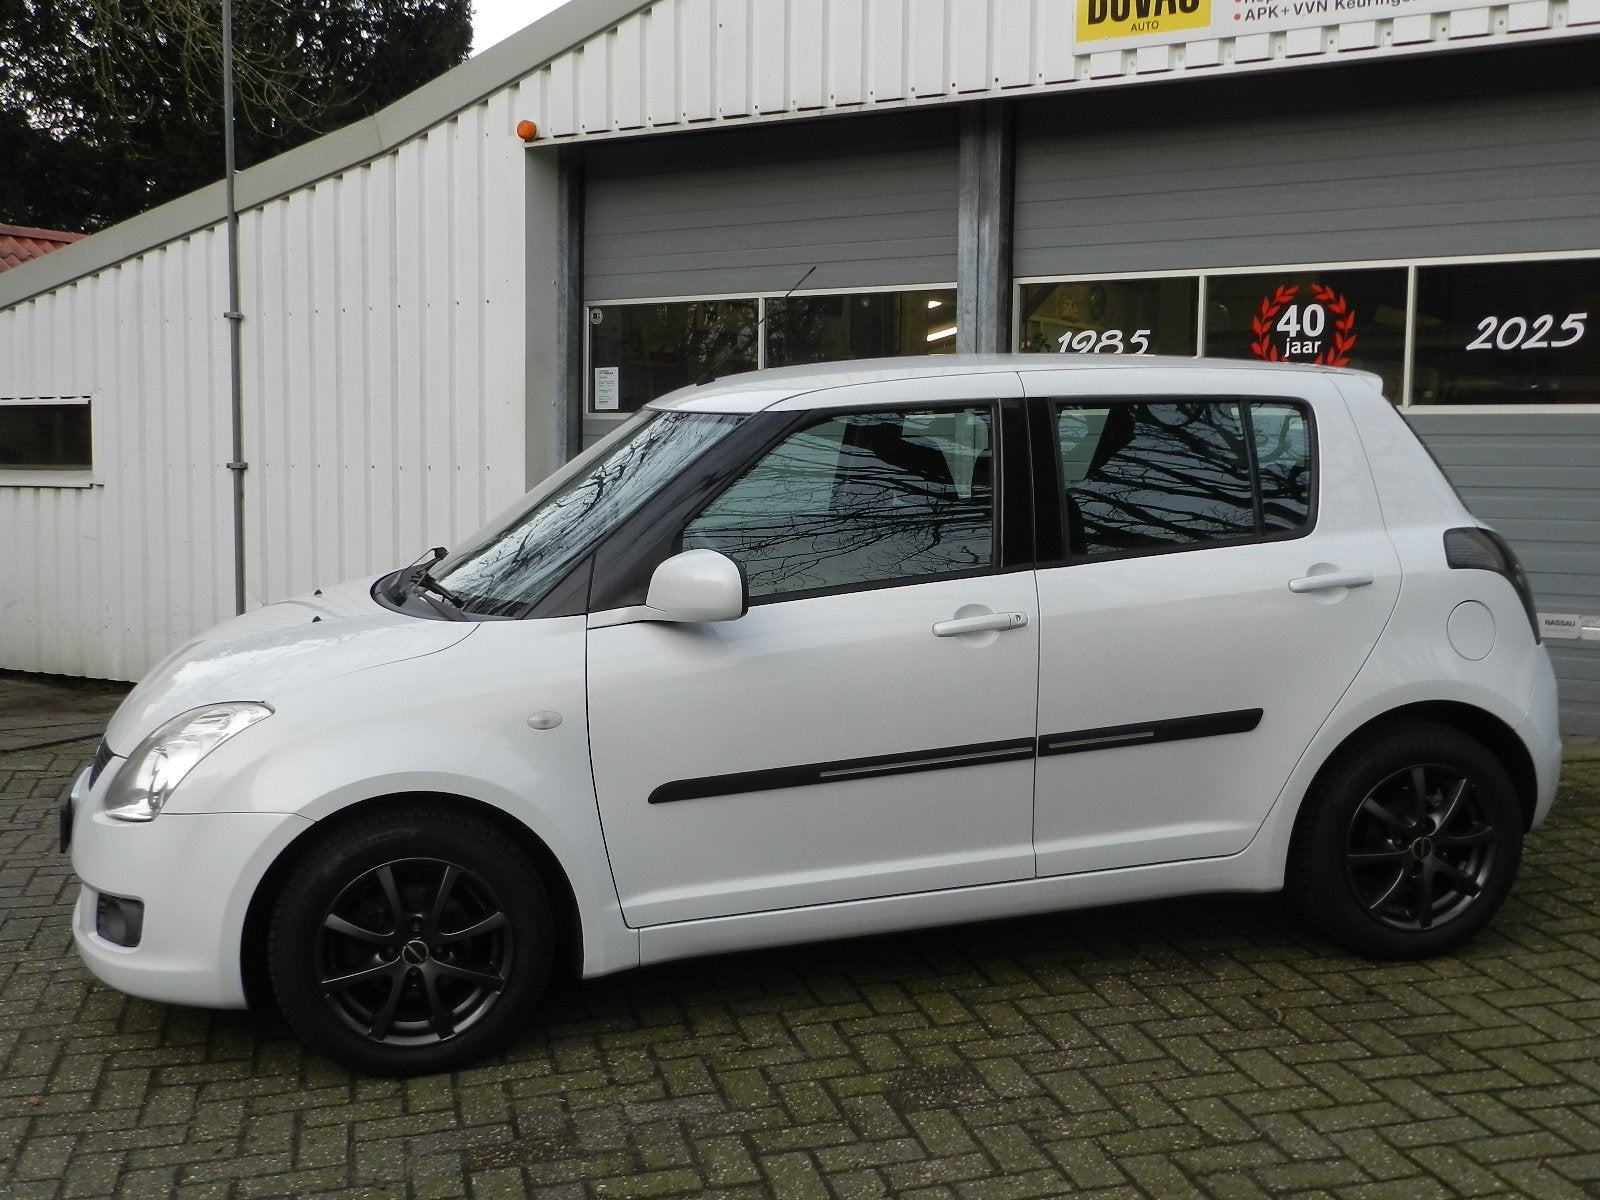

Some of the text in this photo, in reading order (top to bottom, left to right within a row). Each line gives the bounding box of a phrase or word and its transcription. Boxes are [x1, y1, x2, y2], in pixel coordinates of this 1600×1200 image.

[1131, 21, 1159, 32] AUTO
[1276, 303, 1325, 338] 40
[1465, 312, 1588, 350] 2025
[1057, 329, 1151, 355] 1985
[1284, 337, 1321, 358] jaar
[1544, 619, 1576, 627] NASSAU
